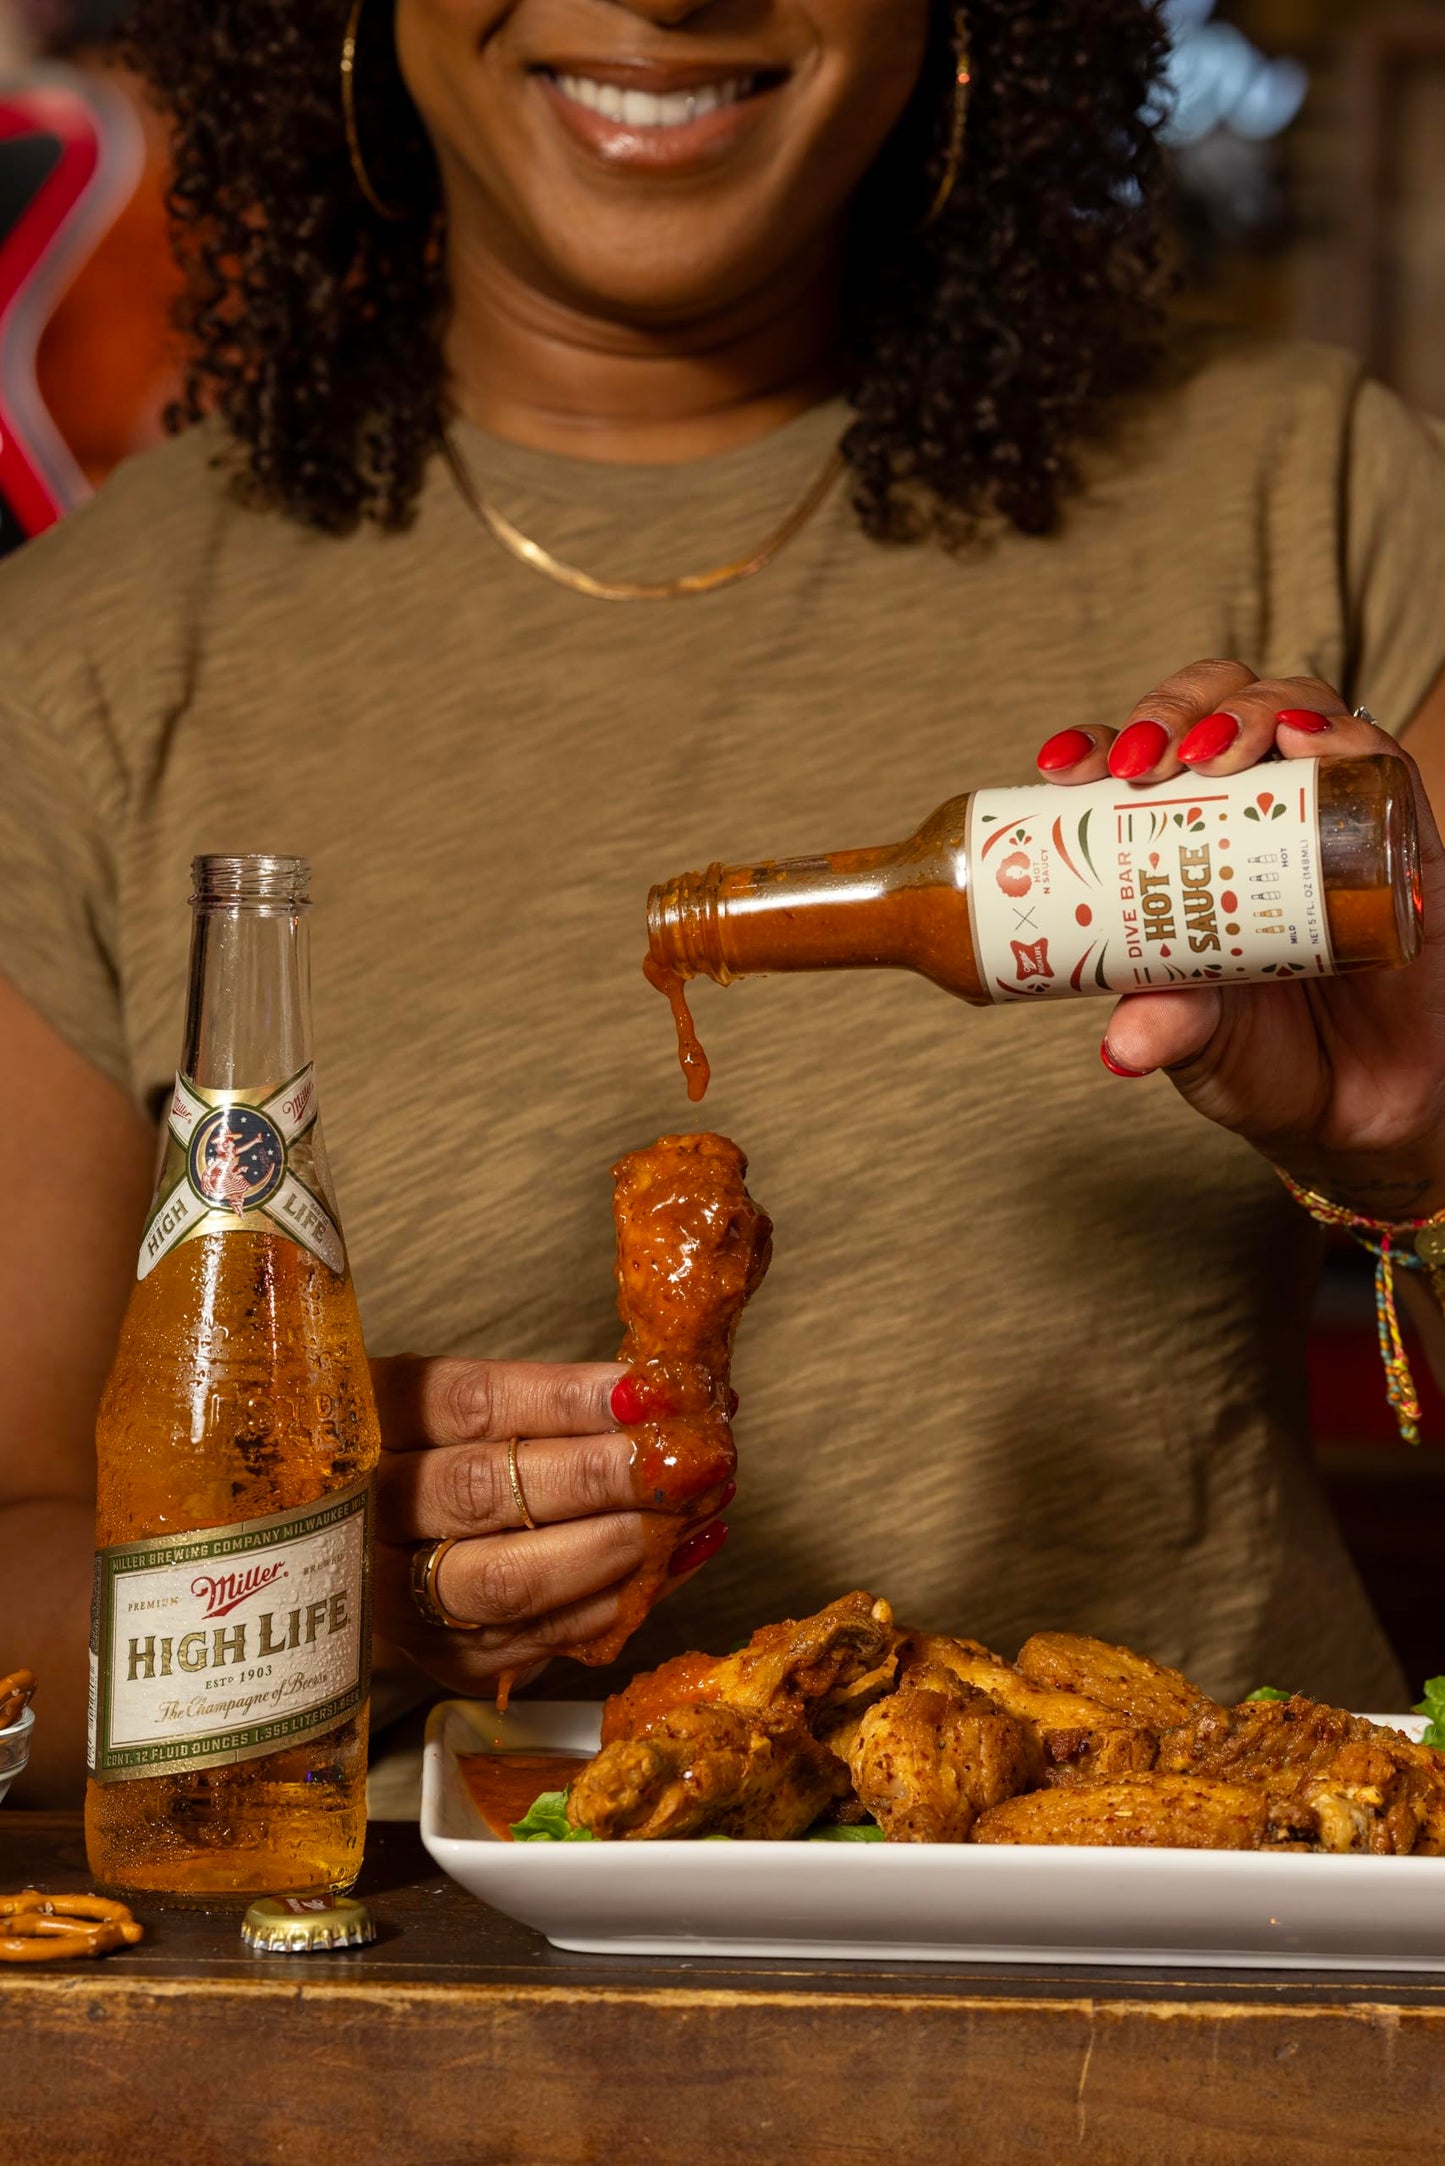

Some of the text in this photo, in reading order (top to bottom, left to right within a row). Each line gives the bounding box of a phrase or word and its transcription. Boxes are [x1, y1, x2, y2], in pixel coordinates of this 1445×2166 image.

[1033, 861, 1041, 883] HOT
[1040, 848, 1051, 895] N SAUCY
[1280, 848, 1289, 867] HOT
[1300, 840, 1312, 880] (148ML)
[1118, 852, 1143, 958] DIVE BAR
[1138, 868, 1177, 942] HOT
[1178, 843, 1222, 953] SAUCE
[1304, 883, 1313, 898] OZ
[1306, 901, 1315, 916] FL.
[1288, 925, 1298, 945] MILD
[1309, 928, 1320, 945] NET
[1034, 945, 1046, 974] HIGH LIFE
[282, 1081, 315, 1124] Miller
[148, 1198, 188, 1258] HIGH
[282, 1193, 326, 1243] LIFE
[112, 1555, 146, 1571] MILLER
[149, 1545, 209, 1564] BREWING
[213, 1528, 280, 1554] COMPANY
[283, 1503, 350, 1538] MILWAUKEE
[128, 1597, 179, 1612] PREMIUM
[191, 1561, 286, 1620] Miller
[126, 1590, 348, 1681] HIGH LIFE
[239, 1665, 273, 1683] 1903
[154, 1700, 185, 1723] The
[186, 1691, 271, 1719] Champagne
[271, 1679, 287, 1708] of
[106, 1752, 133, 1767] CONT.
[135, 1751, 149, 1762] 12
[150, 1744, 189, 1760] FLUID
[191, 1732, 249, 1754] OUNCES
